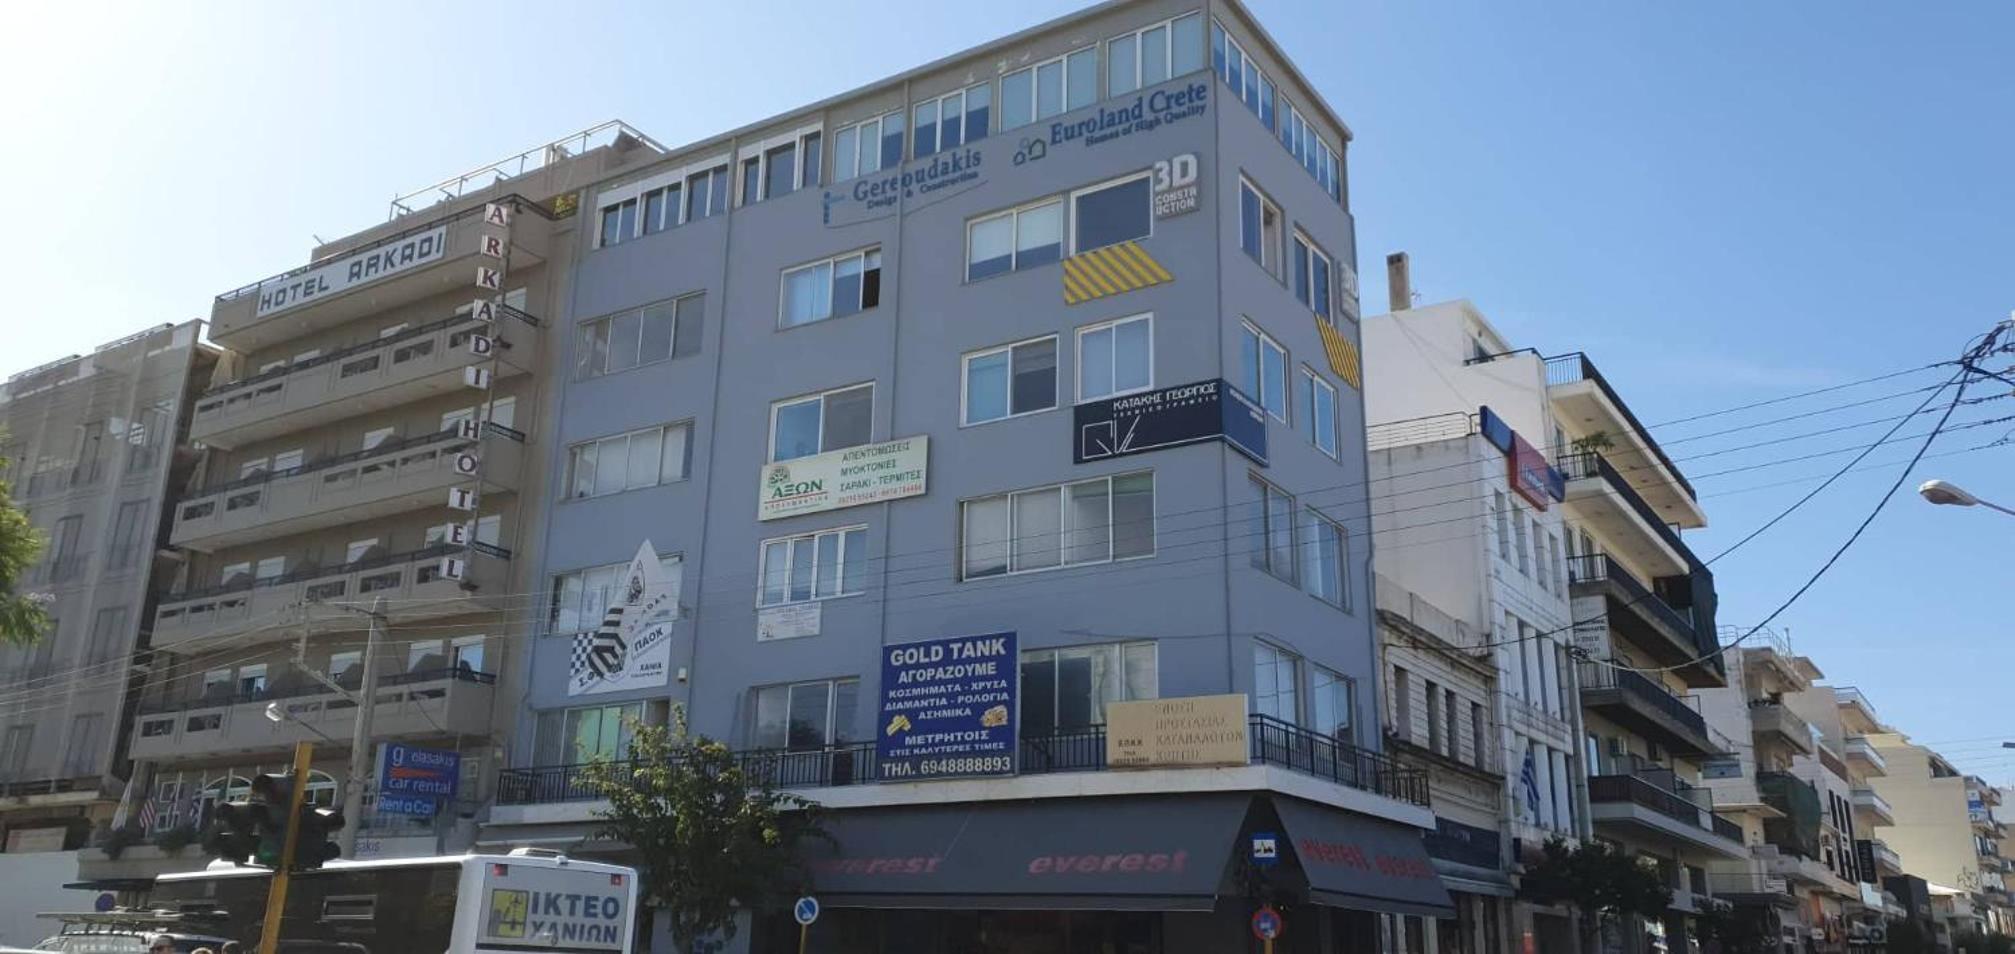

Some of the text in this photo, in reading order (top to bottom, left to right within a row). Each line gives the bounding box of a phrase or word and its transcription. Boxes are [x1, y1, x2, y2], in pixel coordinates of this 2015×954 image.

[1050, 83, 1207, 146] Euroland Crete
[1085, 130, 1120, 147] Homes
[1120, 123, 1134, 136] of
[1164, 103, 1207, 124] Quality
[919, 171, 980, 194] Construction
[1154, 154, 1198, 192] 3D
[259, 231, 445, 312] HOTEL ARKADI
[447, 206, 506, 579] ARKADI HOTEL
[1113, 382, 1218, 411] ΚΑΤΑΚΗΣ ΓΕΩΡΓΙΟΣ
[841, 459, 896, 476] ΜΥΟΚΤΟΝΙΕΣ
[772, 479, 823, 499] ΑΞΩΝ
[634, 627, 664, 651] ΠΑΟΚ
[890, 638, 1007, 666] GOLD TANK
[898, 661, 997, 684] ΑΓΟΡΑΖΟΥΜΕ
[888, 682, 962, 699] ΚΟΣΜΗΜΑΤΑ
[971, 679, 1008, 691] ΧΡΥΣΑ
[884, 696, 948, 711] ΔΙΑΜΑΝΤΙΑ
[957, 692, 1010, 705] ΡΟΛΟΓΙΑ
[918, 707, 973, 721] ΑΣΗΜΙΚΑ
[904, 730, 990, 746] ΜΕΤΡΗΤΟΙΣ
[974, 741, 1006, 751] ΤΙΜΕΣ
[882, 756, 1011, 777] ΤΗΛ. 6948888893
[388, 779, 451, 794] car rental
[1028, 848, 1190, 877] everest
[531, 891, 620, 920] ΙΚΤΕΟ
[530, 920, 618, 946] ΧΑΝΙΩΝ
